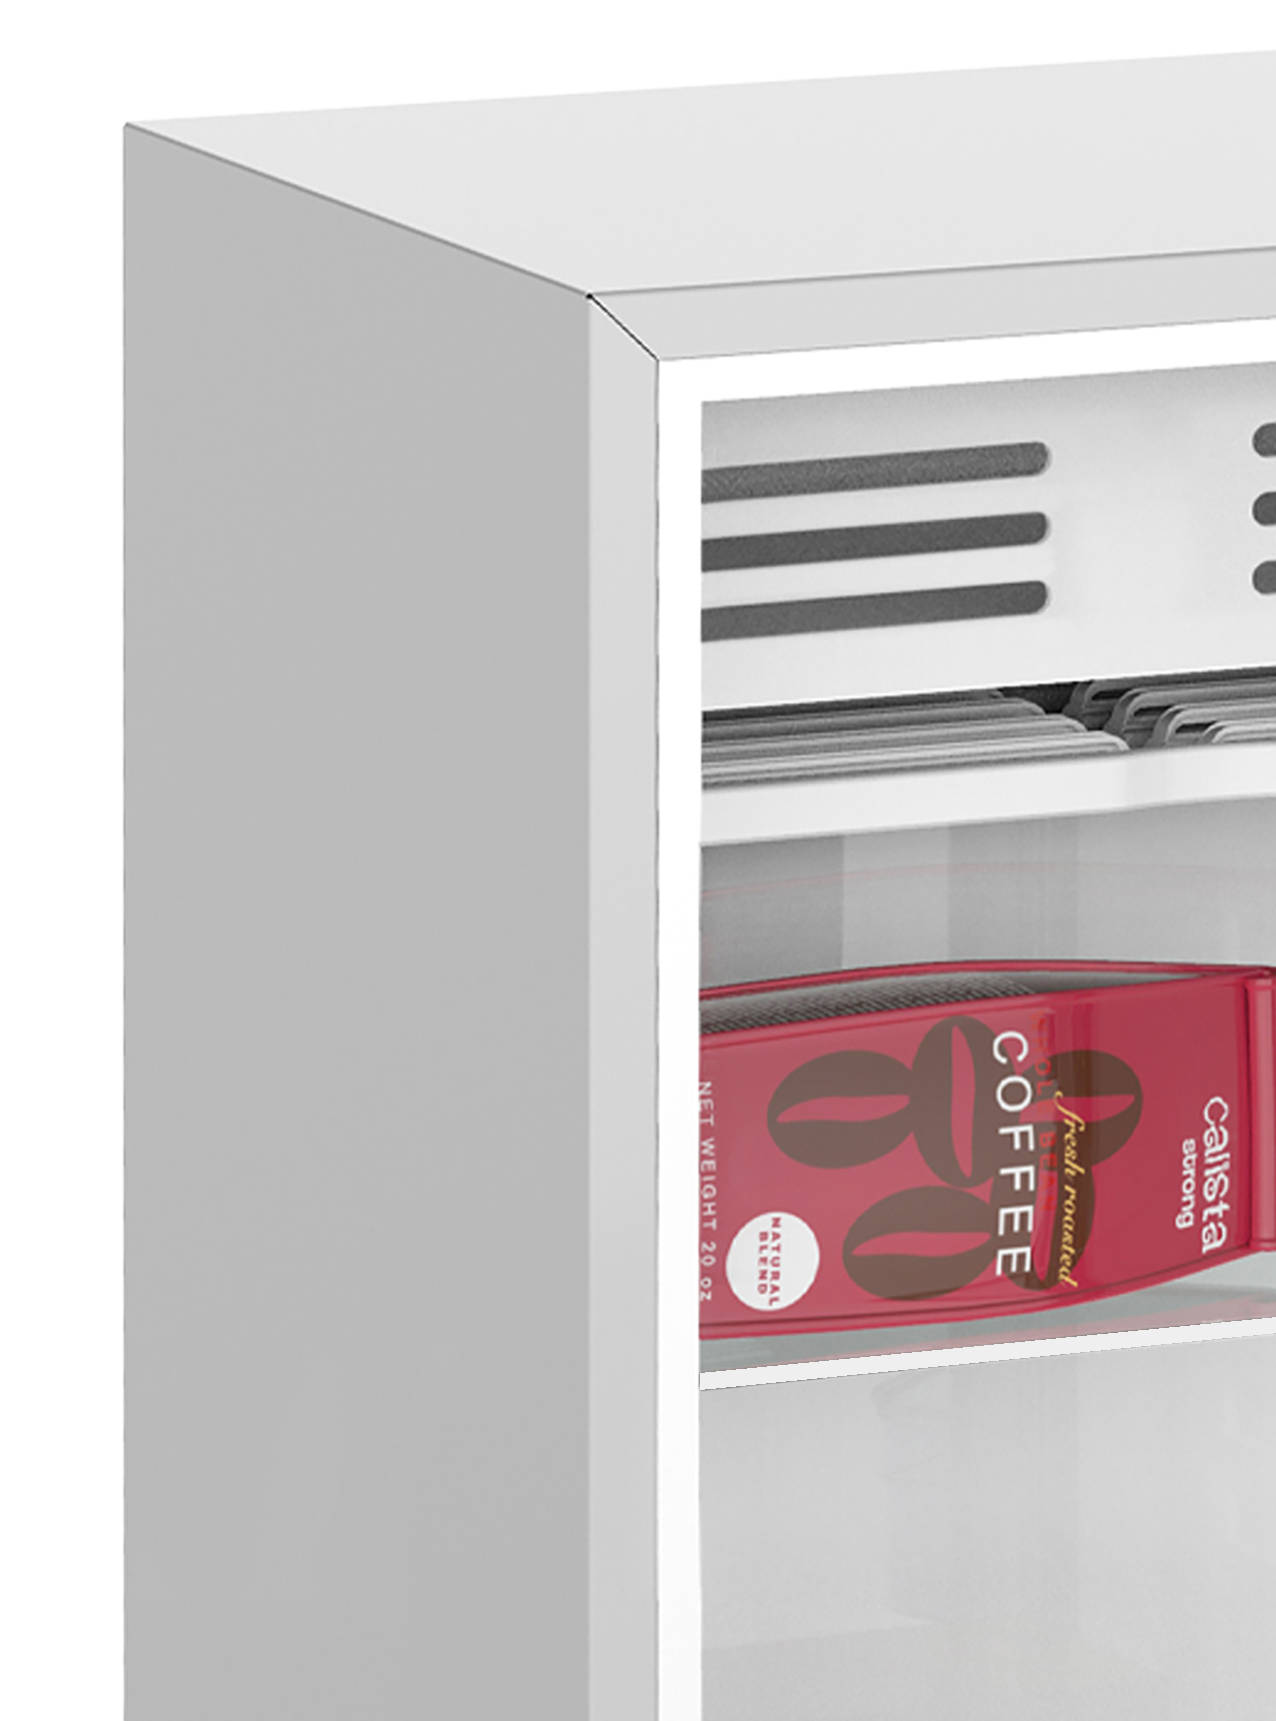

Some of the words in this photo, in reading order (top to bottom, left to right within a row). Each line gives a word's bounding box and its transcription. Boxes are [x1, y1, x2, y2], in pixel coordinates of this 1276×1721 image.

[993, 1030, 1035, 1277] COFFEE
[1055, 1090, 1085, 1178] fresh
[701, 1137, 717, 1231] WEIGHT
[1175, 1137, 1197, 1230] strong
[701, 1241, 717, 1267] 20
[757, 1231, 768, 1295] BLEND
[769, 1217, 782, 1306] NATURAL
[1058, 1184, 1078, 1287] roasted
